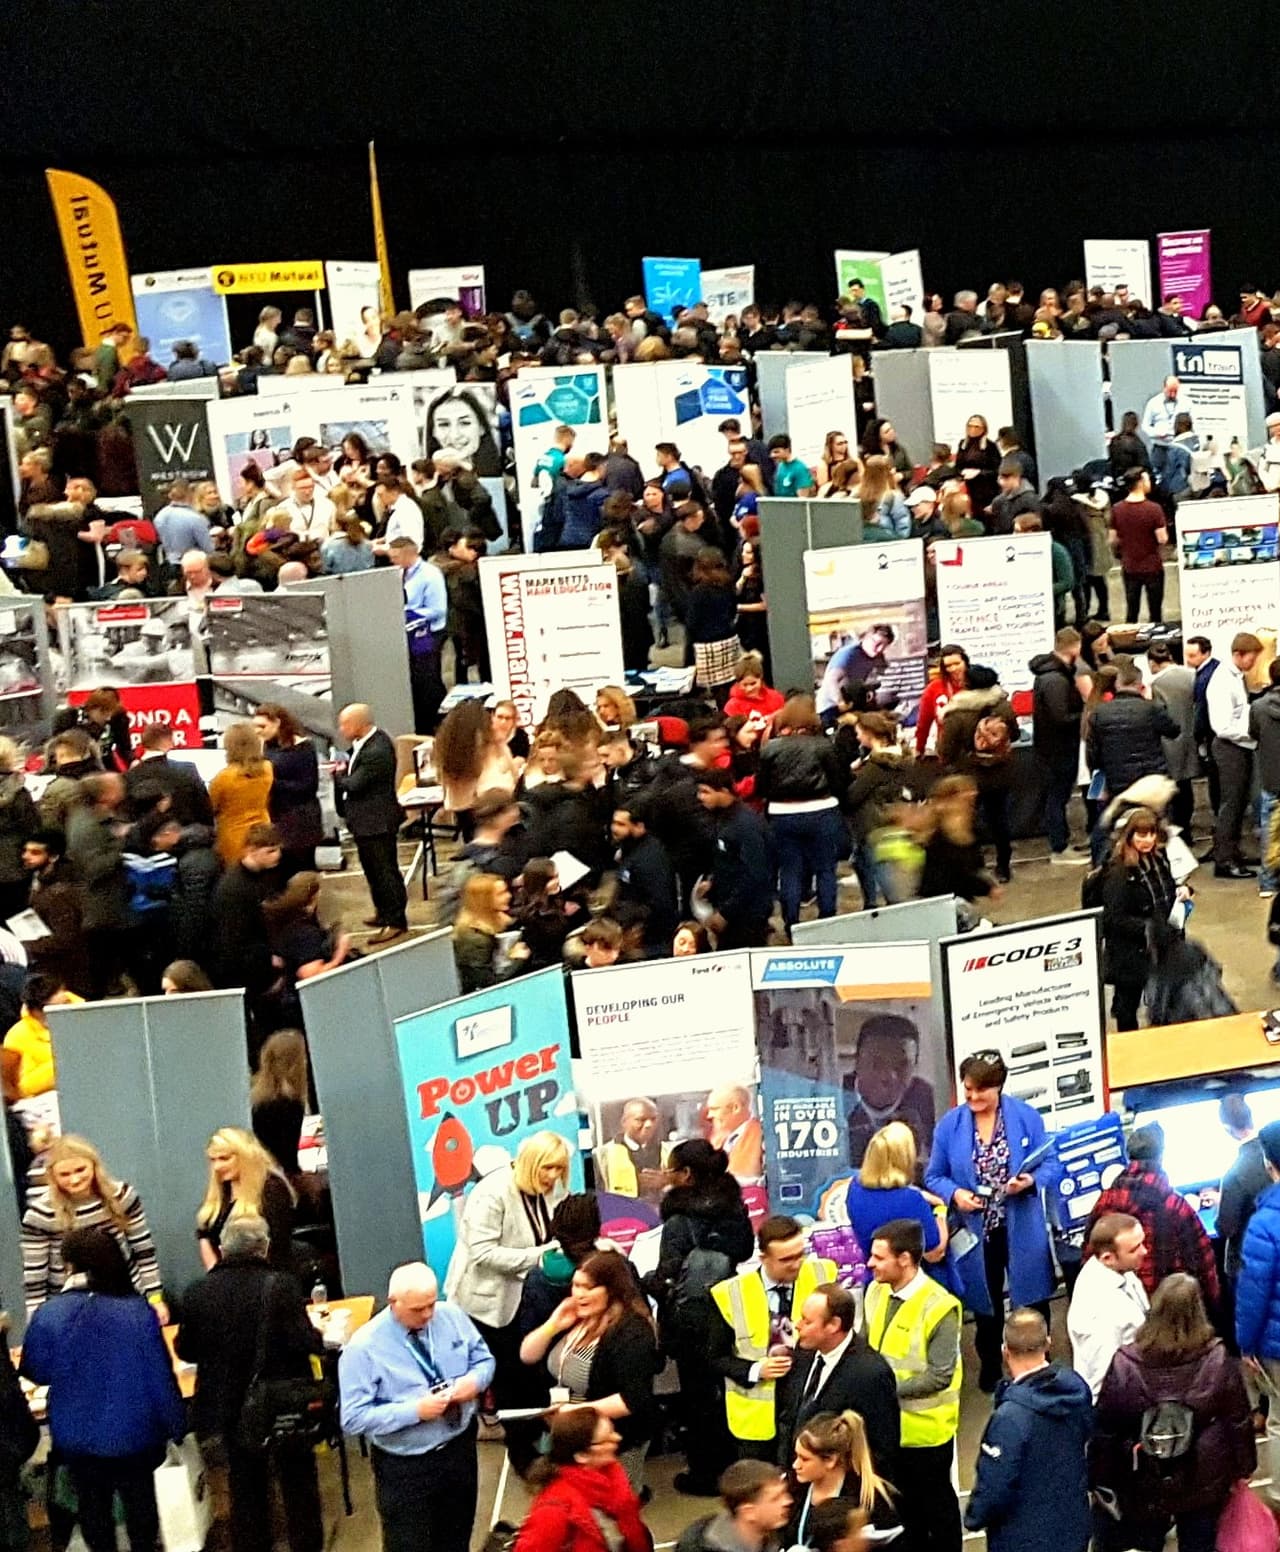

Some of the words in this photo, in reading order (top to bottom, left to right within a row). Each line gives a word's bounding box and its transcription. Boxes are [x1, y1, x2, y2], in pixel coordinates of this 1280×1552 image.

[270, 270, 319, 282] Mutual
[1174, 350, 1204, 373] tn
[525, 577, 555, 587] MARK
[557, 574, 590, 584] BETTS
[553, 582, 613, 595] EDUCATION
[1191, 607, 1214, 618] Our
[1219, 602, 1262, 615] success
[1217, 614, 1255, 628] people
[175, 708, 193, 726] A
[986, 940, 1062, 968] CODE
[1064, 937, 1083, 952] 3
[768, 958, 836, 973] ABSOLUTE
[979, 994, 1013, 1007] Leading
[1015, 982, 1072, 999] Manufacturer
[585, 997, 658, 1016] DEVELOPING
[661, 992, 686, 1005] OUR
[961, 1013, 971, 1022] of
[973, 1004, 1020, 1020] Emergency
[1022, 996, 1051, 1008] Vehicle
[587, 1011, 631, 1027] PEOPLE
[984, 1018, 1001, 1029] and
[1003, 1012, 1030, 1025] Safety
[1032, 1004, 1070, 1017] Products
[416, 1042, 561, 1120] Power
[484, 1078, 560, 1137] UP
[774, 1110, 790, 1122] IN
[795, 1108, 836, 1121] OVER
[774, 1119, 839, 1150] 170
[776, 1148, 840, 1159] INDUSTRIES
